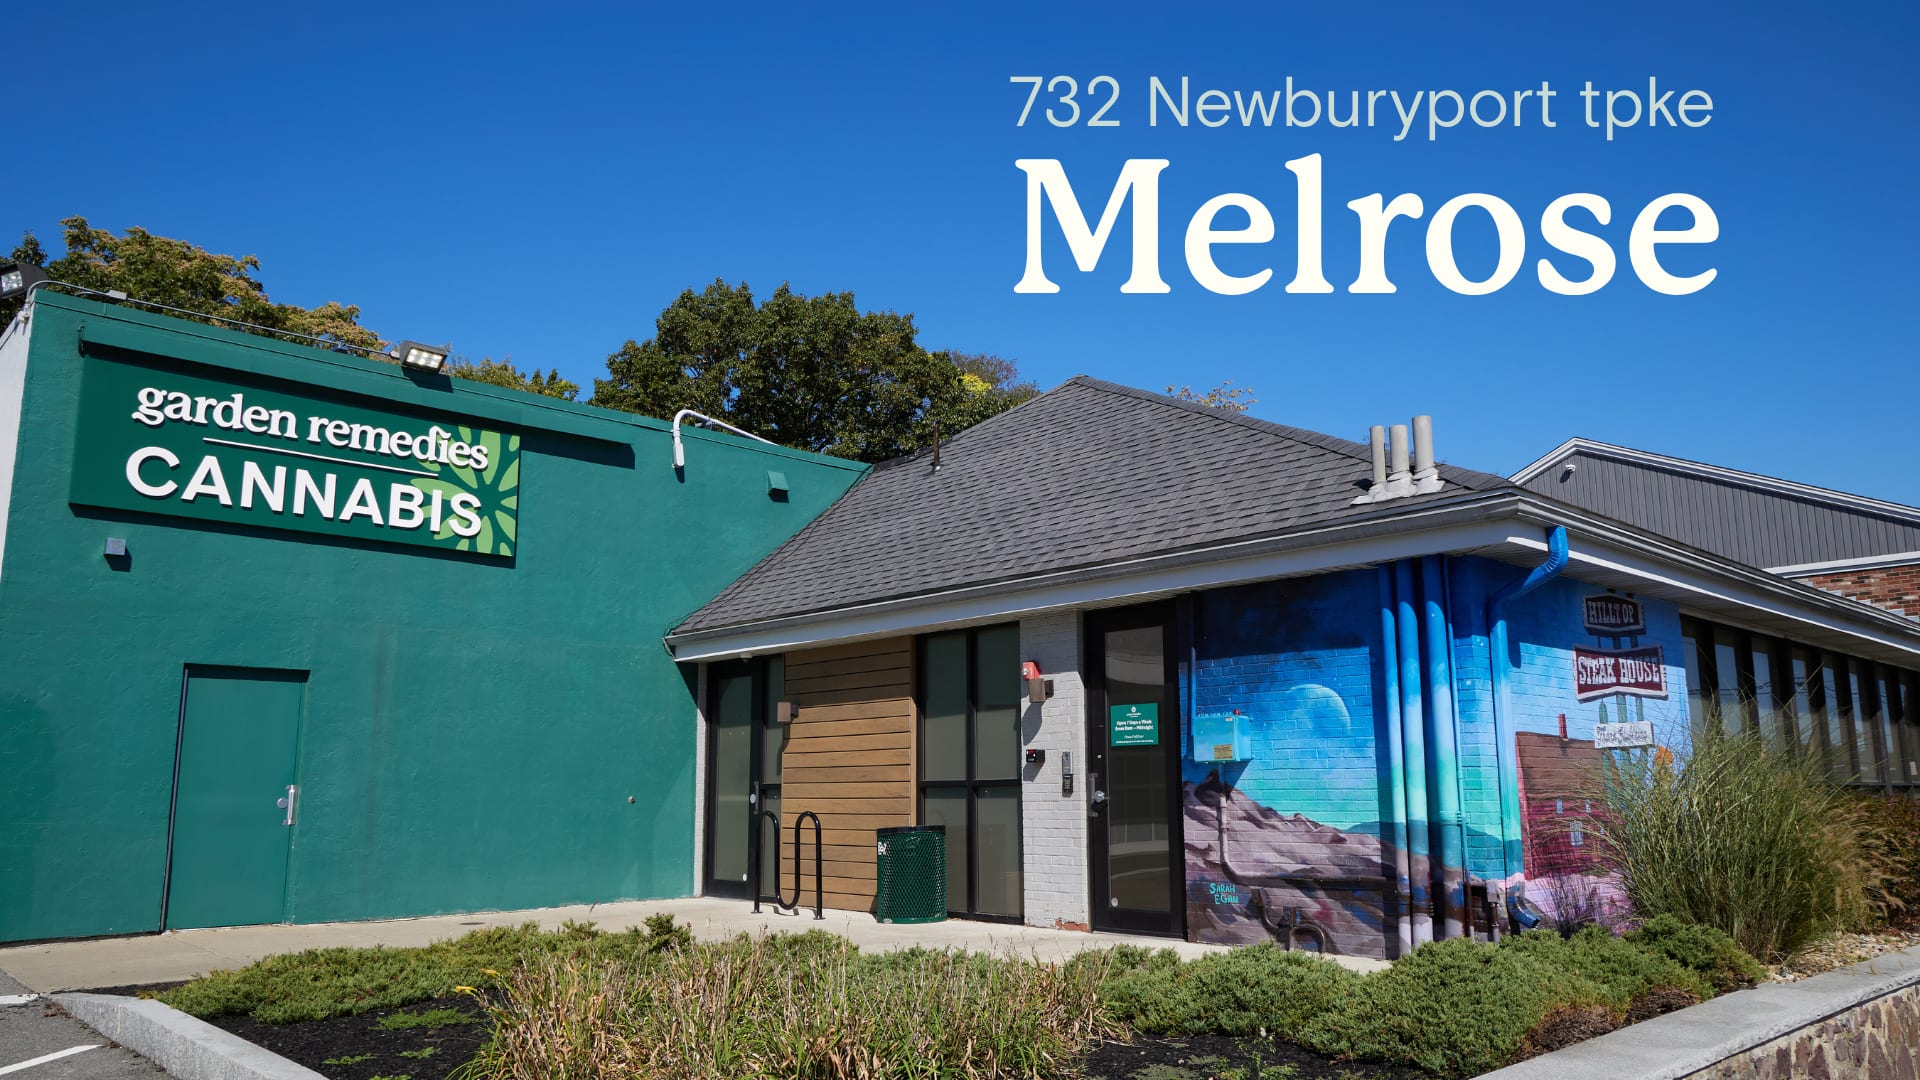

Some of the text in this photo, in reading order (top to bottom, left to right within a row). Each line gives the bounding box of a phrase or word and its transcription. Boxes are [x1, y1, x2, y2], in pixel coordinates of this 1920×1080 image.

[131, 387, 489, 470] garden remedies
[125, 446, 483, 538] CANNABIS
[1577, 656, 1660, 685] STEAK HOUSE
[1214, 893, 1239, 905] EGAN
